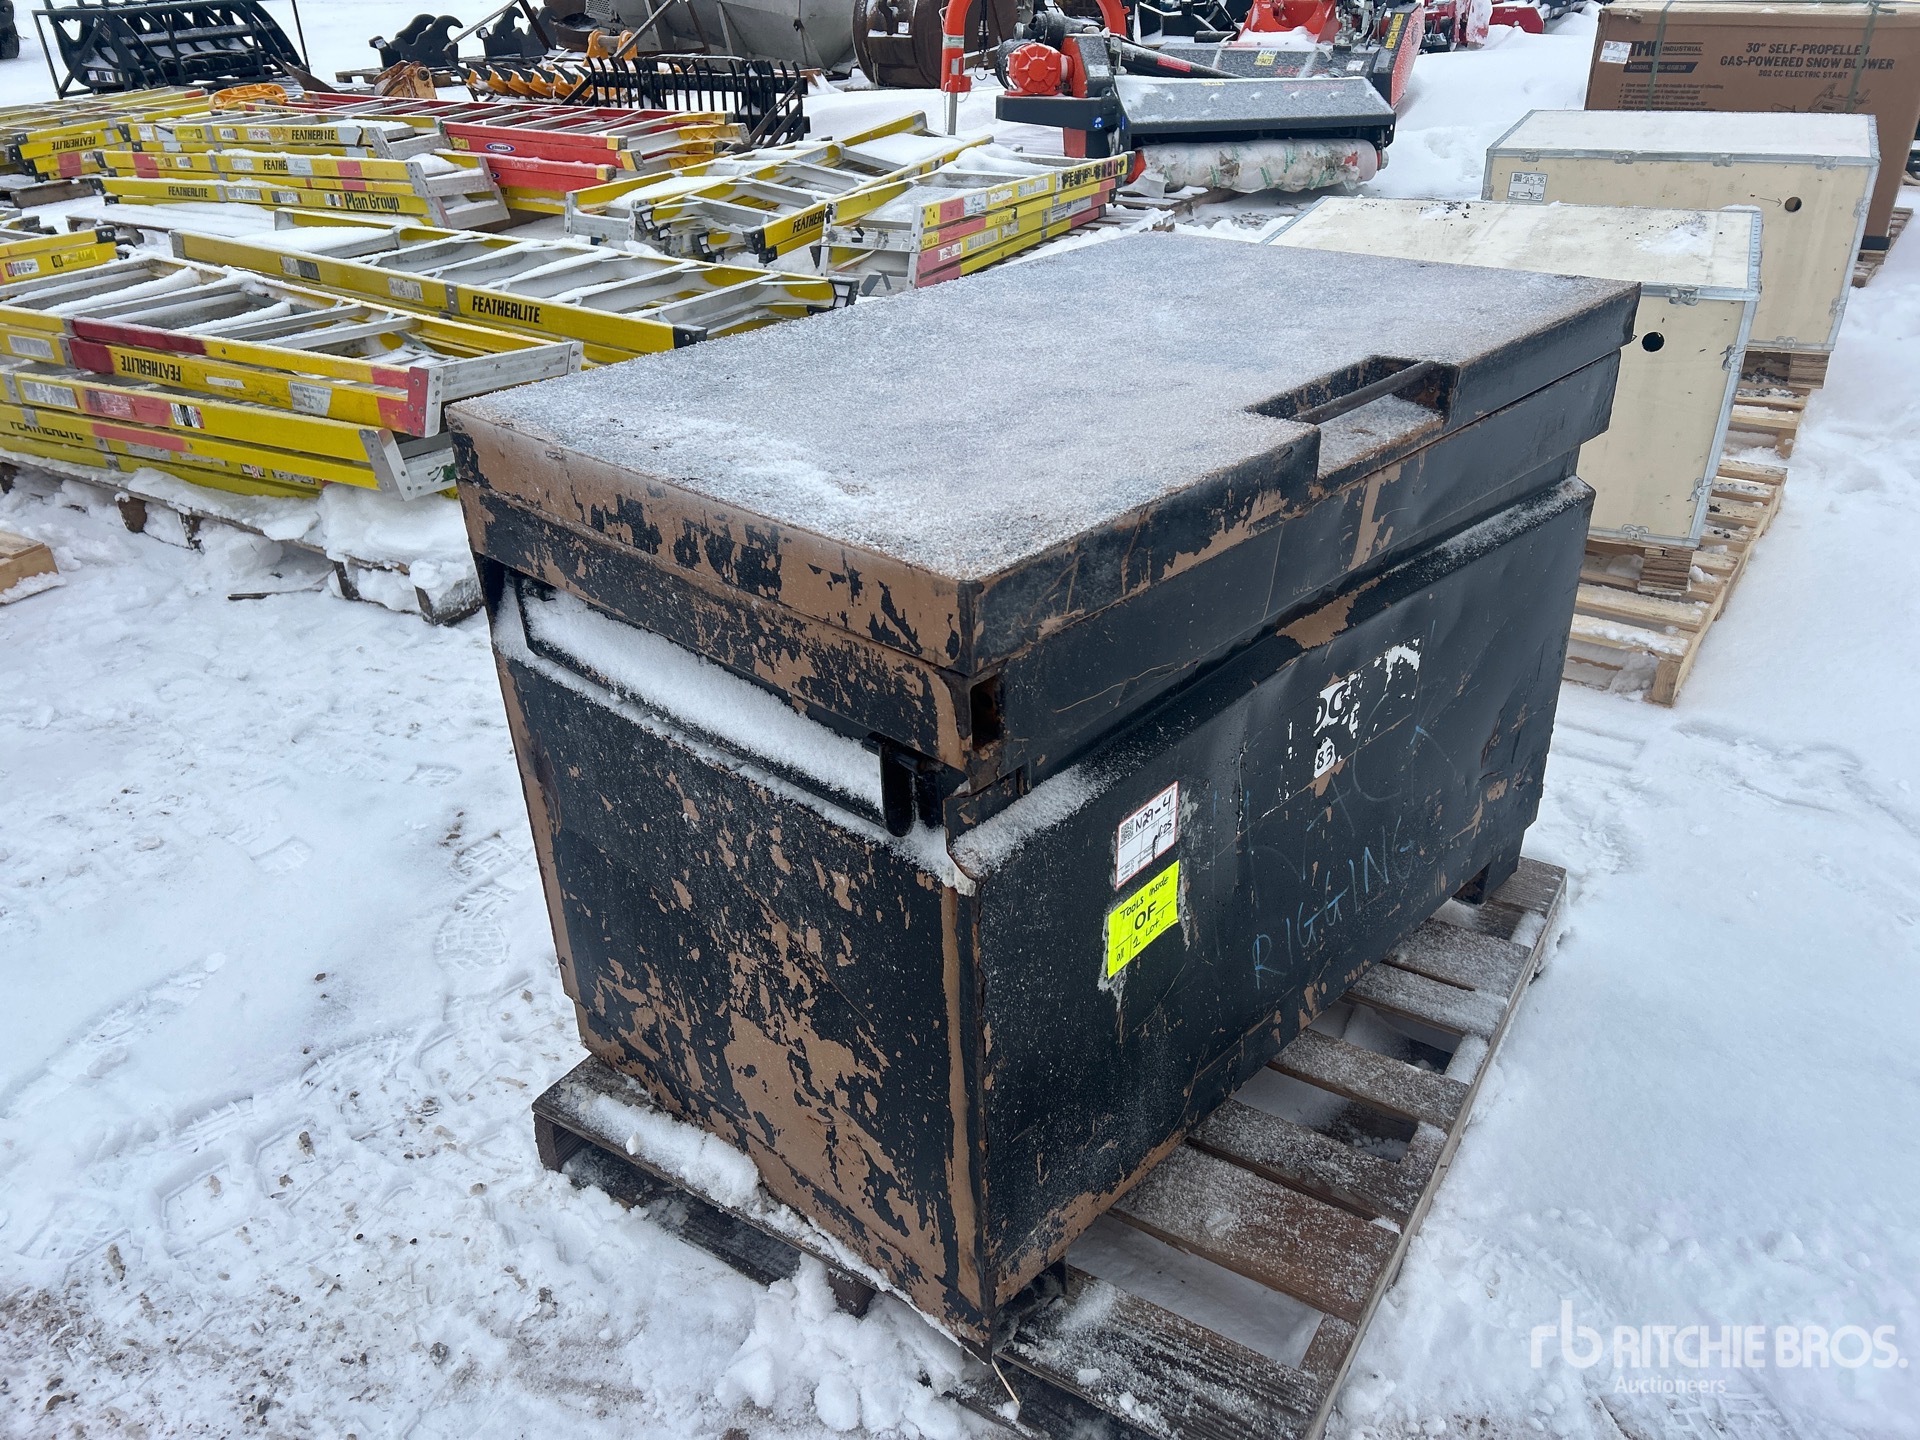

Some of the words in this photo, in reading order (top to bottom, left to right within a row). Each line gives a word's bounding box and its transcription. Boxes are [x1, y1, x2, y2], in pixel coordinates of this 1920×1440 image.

[1720, 55, 1803, 68] GAS-POWERED
[1805, 57, 1845, 69] SNOW
[1785, 70, 1820, 78] ELECTRIC
[51, 135, 96, 150] FEATHERLITE
[168, 186, 208, 198] FEATHERLITE
[344, 192, 368, 211] Plan
[369, 193, 399, 212] Group
[472, 295, 541, 323] FEATHERLITE
[121, 355, 181, 382] FEATHERLITE
[1316, 744, 1333, 770] 83
[1135, 794, 1172, 832] N29-4
[1134, 901, 1157, 930] OF
[1252, 815, 1416, 990] RIGGING
